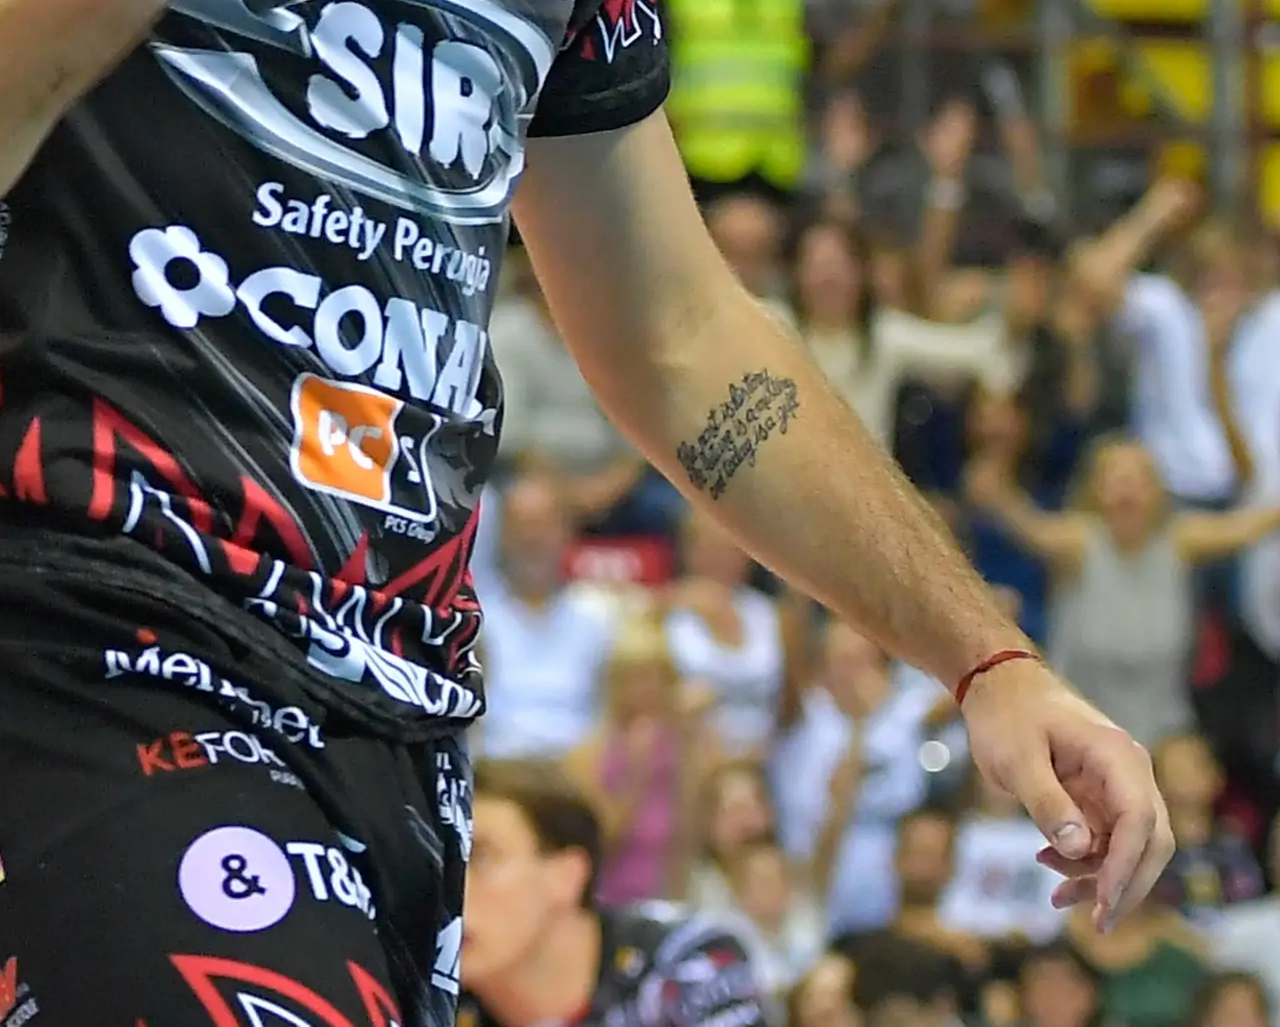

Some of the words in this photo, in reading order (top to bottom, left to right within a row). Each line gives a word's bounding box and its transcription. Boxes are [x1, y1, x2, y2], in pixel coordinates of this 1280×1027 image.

[306, 0, 503, 181] SIR
[252, 181, 386, 261] Safety
[394, 216, 491, 296] Perugia
